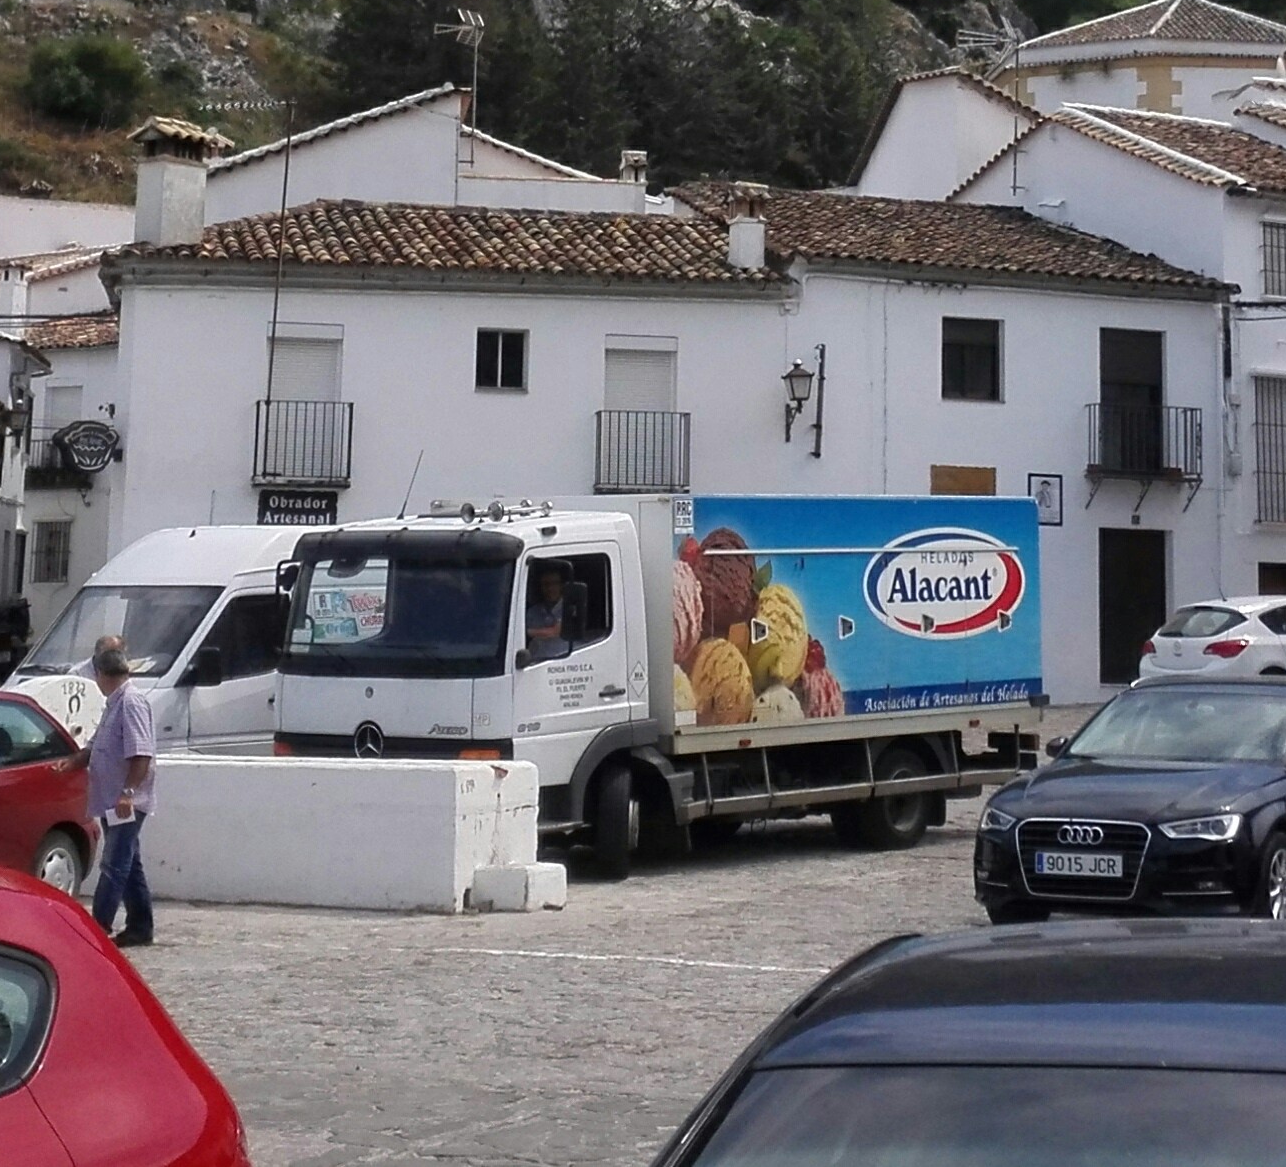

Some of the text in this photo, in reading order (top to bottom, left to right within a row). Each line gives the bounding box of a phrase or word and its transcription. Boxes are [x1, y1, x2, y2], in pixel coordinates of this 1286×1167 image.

[269, 495, 328, 509] Obrador
[263, 511, 331, 524] Artesanal
[920, 551, 974, 565] HELADOS
[887, 566, 993, 604] Alacant
[864, 683, 1029, 713] Asociación de Artesanos del Helado
[1046, 855, 1116, 874] 9015 JCR
